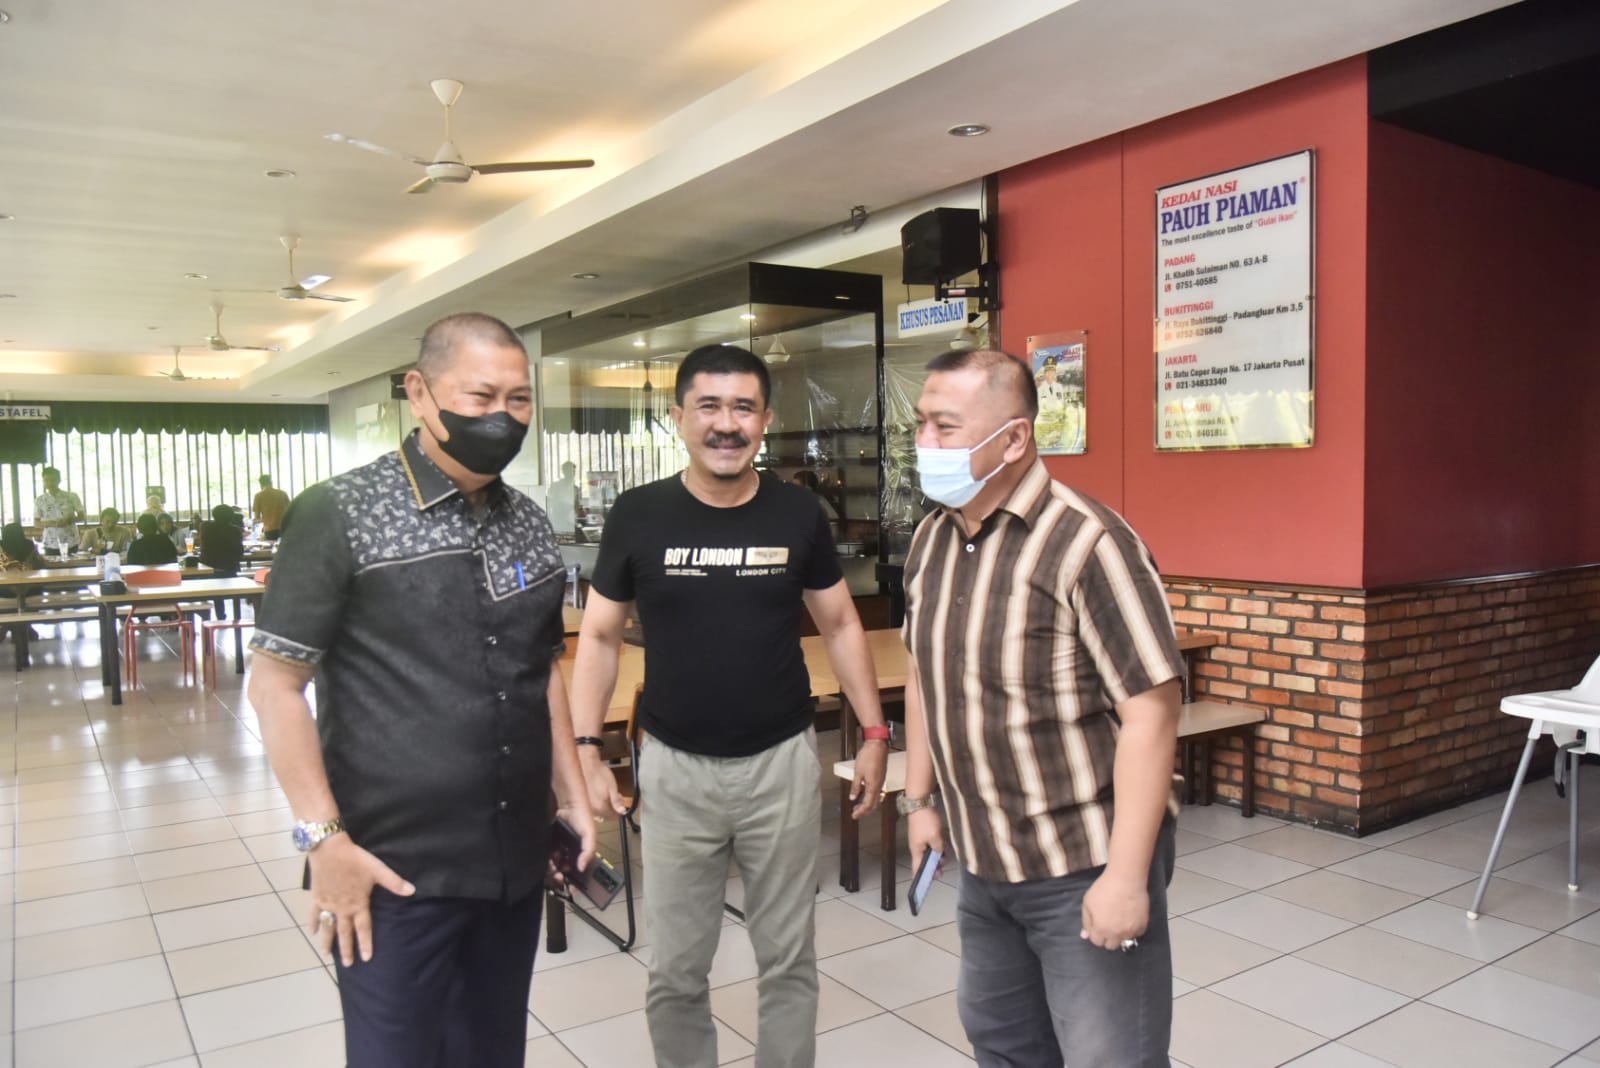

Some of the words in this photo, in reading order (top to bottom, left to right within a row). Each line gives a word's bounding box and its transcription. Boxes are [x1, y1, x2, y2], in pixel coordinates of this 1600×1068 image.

[1161, 189, 1202, 209] KEDAI
[1205, 180, 1238, 199] NASI
[1161, 202, 1210, 234] PAUH
[1216, 180, 1298, 222] PIAMAN
[1161, 239, 1173, 247] The
[1174, 235, 1190, 245] most
[1191, 227, 1226, 240] excellence
[1227, 223, 1244, 234] taste
[1245, 221, 1253, 229] of
[1164, 254, 1196, 267] PADANG
[1173, 269, 1195, 280] Khatib
[1196, 263, 1228, 275] Sulaiman
[1243, 257, 1253, 266] 63
[1254, 254, 1268, 264] A-B
[1176, 276, 1218, 290] 0751-40585
[900, 308, 929, 330] KHUSUS
[929, 301, 964, 325] PESANAN
[1164, 301, 1214, 316] BUKITTINGGI
[1233, 307, 1275, 320] Padangluar
[1276, 304, 1288, 313] Km
[1290, 302, 1304, 312] 3,5
[1165, 354, 1197, 367] JAKARTA
[1173, 370, 1189, 378] Batu
[1211, 366, 1228, 376] Raya
[1243, 363, 1252, 371] 17
[1253, 360, 1281, 370] Jakarta
[1283, 358, 1305, 367] Pusat
[664, 547, 691, 565] BOY
[691, 547, 744, 566] LONDON
[736, 568, 769, 577] LONDON
[770, 567, 787, 575] CITY
